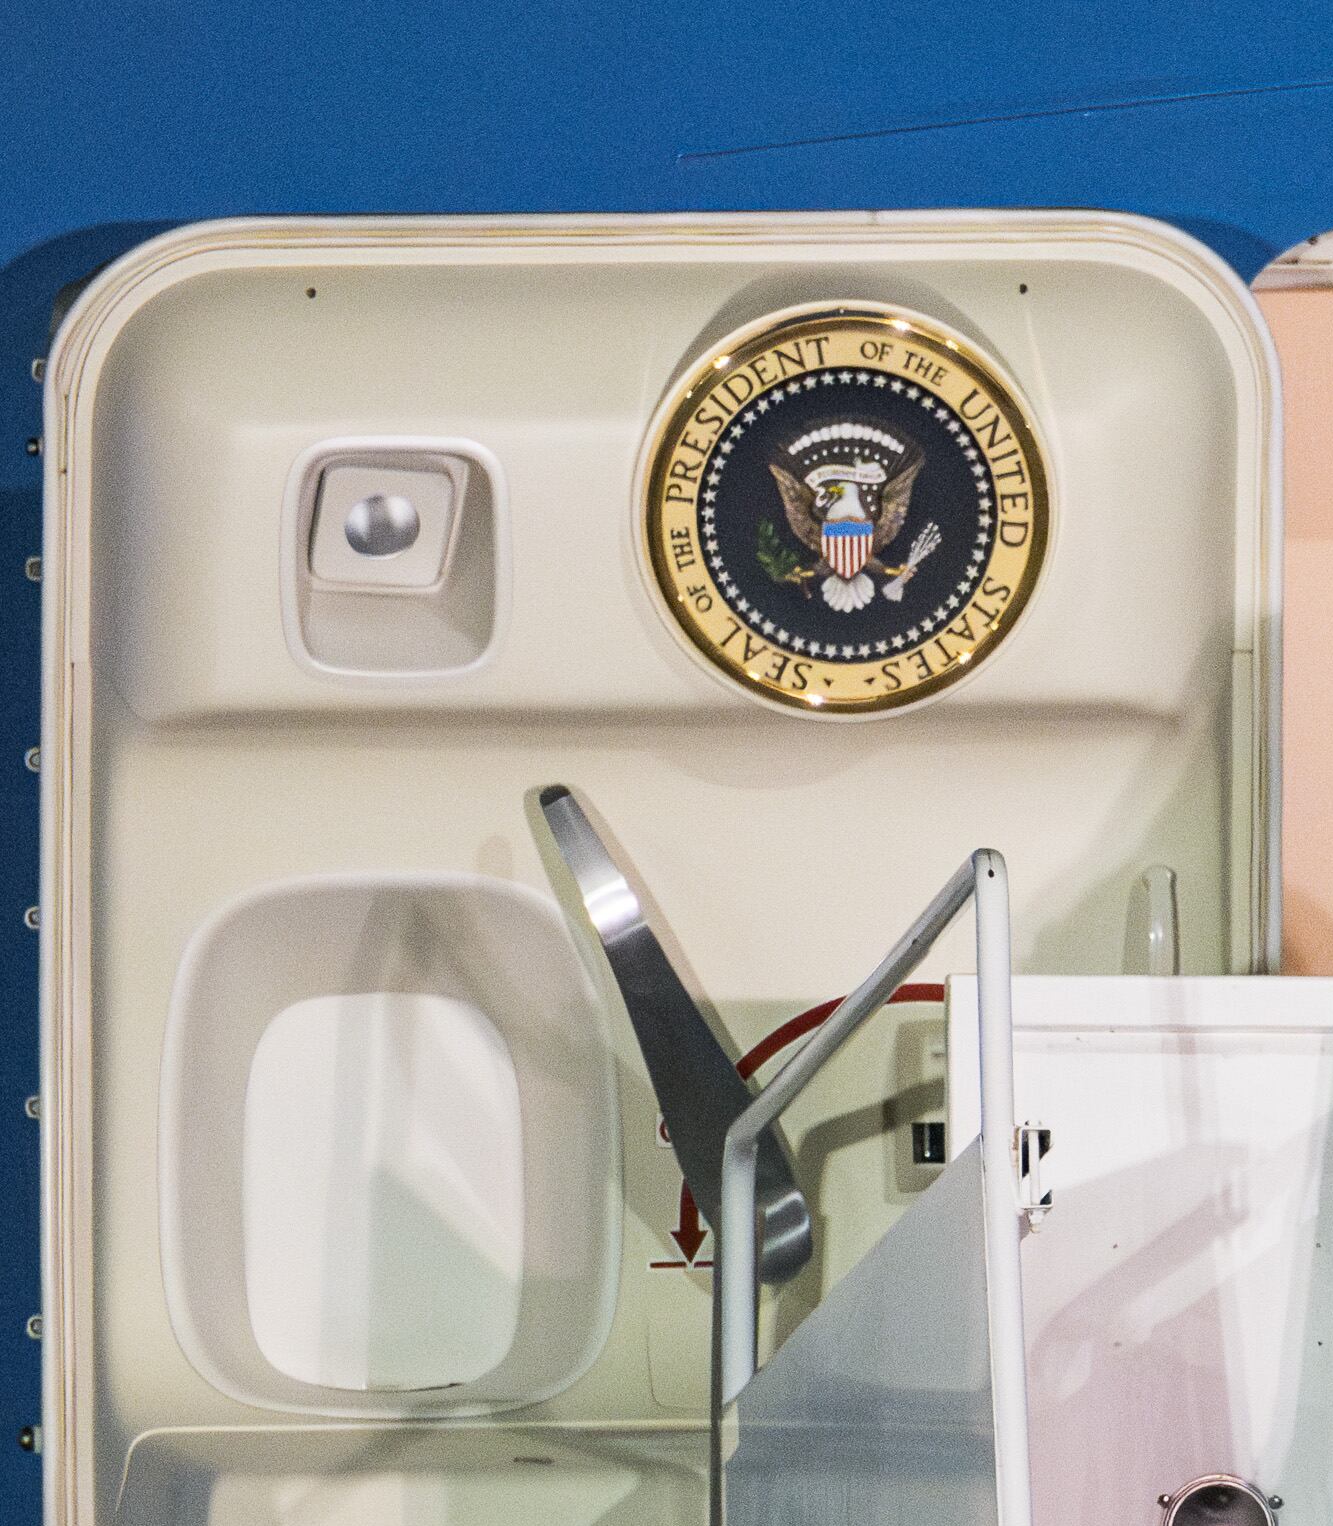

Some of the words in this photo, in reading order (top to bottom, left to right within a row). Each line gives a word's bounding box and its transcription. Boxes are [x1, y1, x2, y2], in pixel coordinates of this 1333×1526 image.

[860, 340, 893, 362] OF
[903, 350, 947, 388] THE
[667, 336, 830, 504] PRESIDENT
[959, 390, 1029, 548] UNITED
[670, 525, 696, 572] THE
[687, 584, 712, 614] OF
[720, 615, 812, 691] SEAL
[880, 576, 1012, 691] STATES
